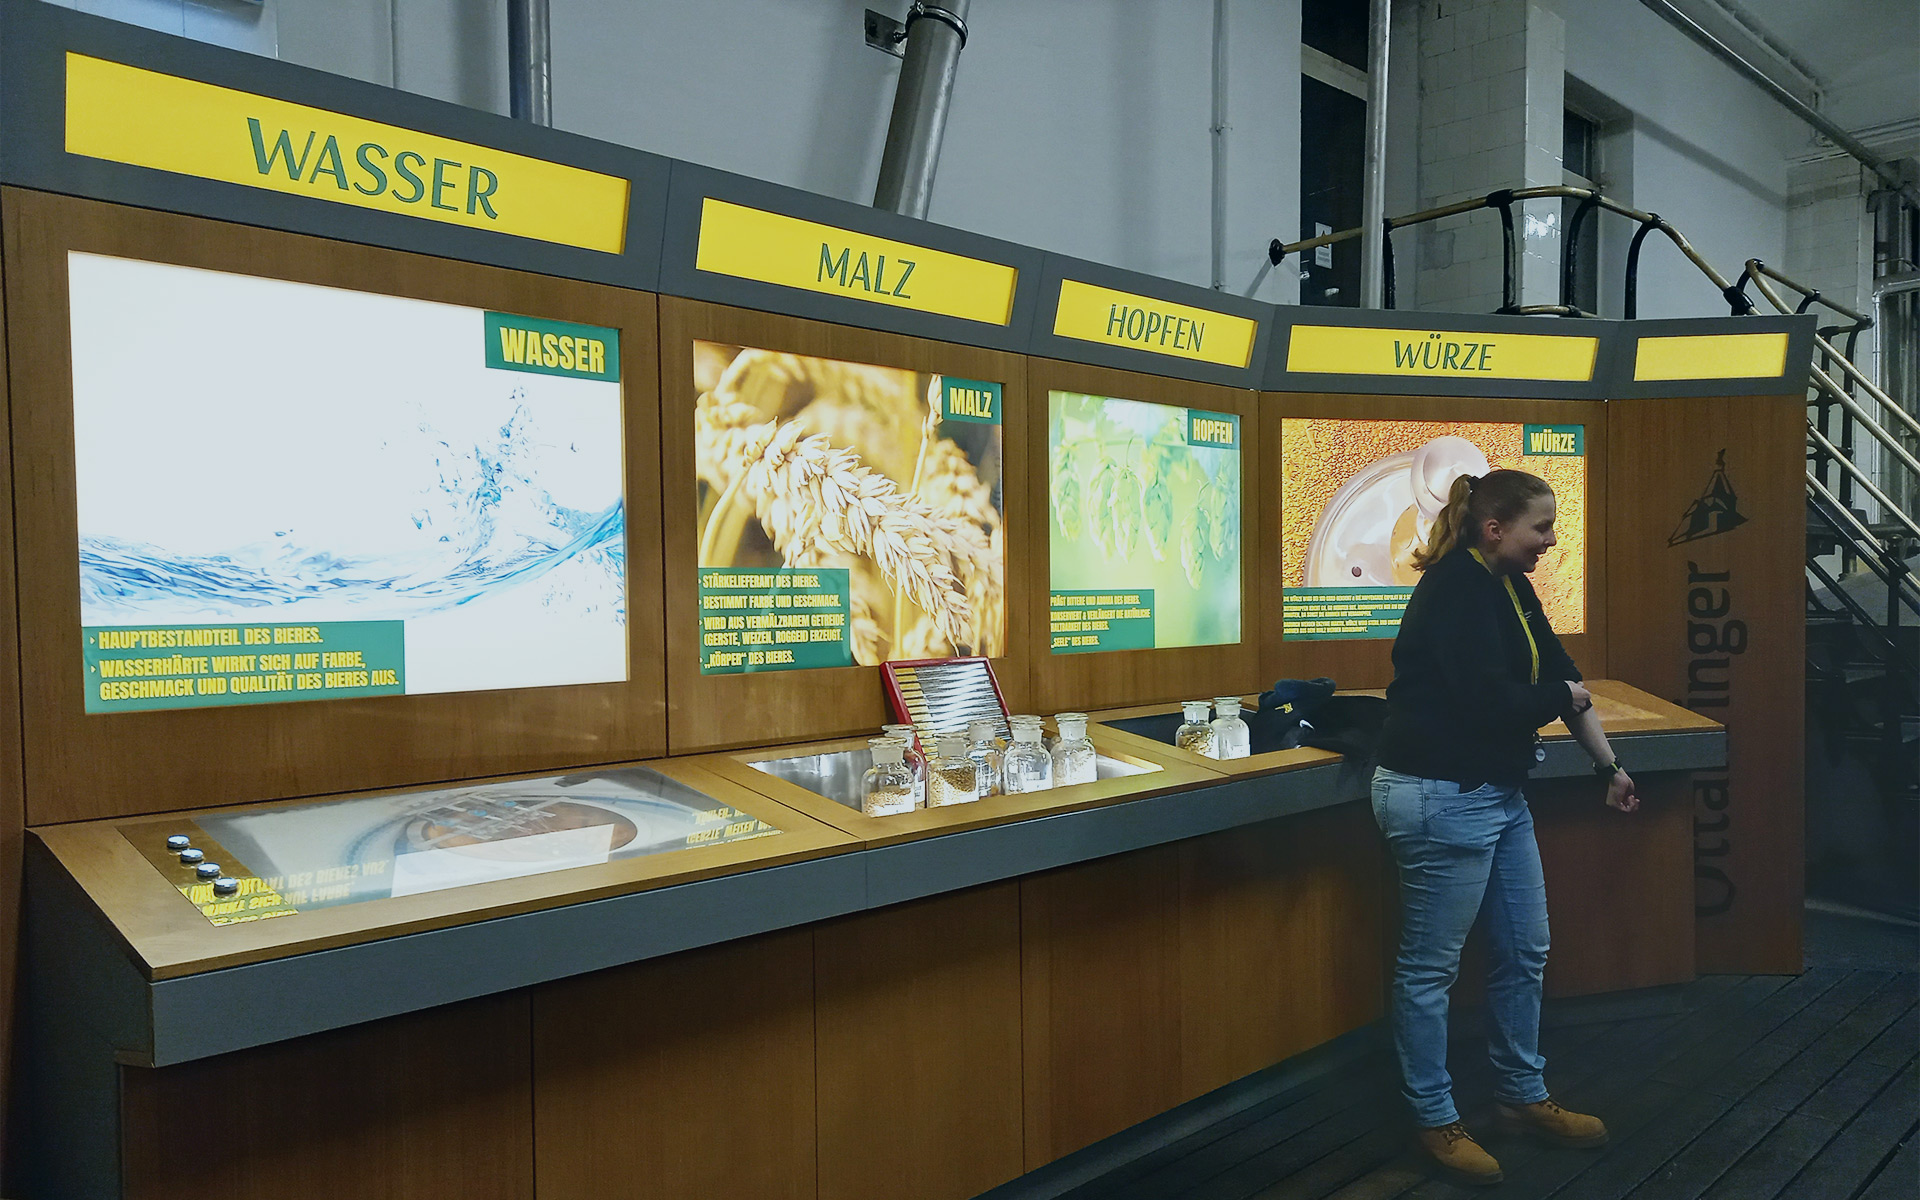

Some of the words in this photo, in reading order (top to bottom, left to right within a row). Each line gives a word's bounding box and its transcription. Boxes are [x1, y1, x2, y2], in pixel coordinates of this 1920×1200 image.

[246, 117, 499, 220] WASSER
[817, 242, 916, 300] MALZ
[1106, 303, 1205, 352] HOPFEN
[499, 326, 605, 374] WASSER
[1394, 333, 1496, 371] WÜRZE
[950, 387, 992, 418] MALZ
[1193, 418, 1233, 445] HOPFEN
[1530, 428, 1576, 453] WÜRZE
[703, 572, 774, 588] STÄRKELIEFERANT
[775, 575, 791, 588] DES
[792, 574, 820, 588] BIERES.
[703, 595, 747, 609] BESTIMMT
[749, 595, 775, 608] FARBE
[775, 595, 791, 608] UND
[793, 594, 841, 608] GESCHMACK.
[704, 616, 726, 630] WIRD
[728, 616, 745, 629] AUS
[746, 613, 809, 629] VERMÄLZBAREM
[811, 614, 844, 627] GETREIDE
[98, 628, 241, 650] HAUPTBESTANDTEIL
[244, 628, 271, 646] DES
[274, 627, 324, 644] BIERES.
[810, 629, 843, 642] ERZEUGT.
[99, 654, 208, 678] WASSERHÄRTE
[211, 655, 256, 674] WIRKT
[259, 653, 292, 671] SICH
[294, 652, 319, 670] AUF
[322, 651, 366, 669] FARBE,
[748, 652, 765, 665] DES
[765, 650, 795, 664] BIERES.
[100, 679, 195, 701] GESCHMACK
[197, 678, 228, 696] UND
[230, 672, 294, 694] QUALITÄT
[296, 673, 322, 691] DES
[325, 671, 368, 689] BIERES
[371, 669, 399, 687] AUS.
[1676, 560, 1748, 918] Ottainger
